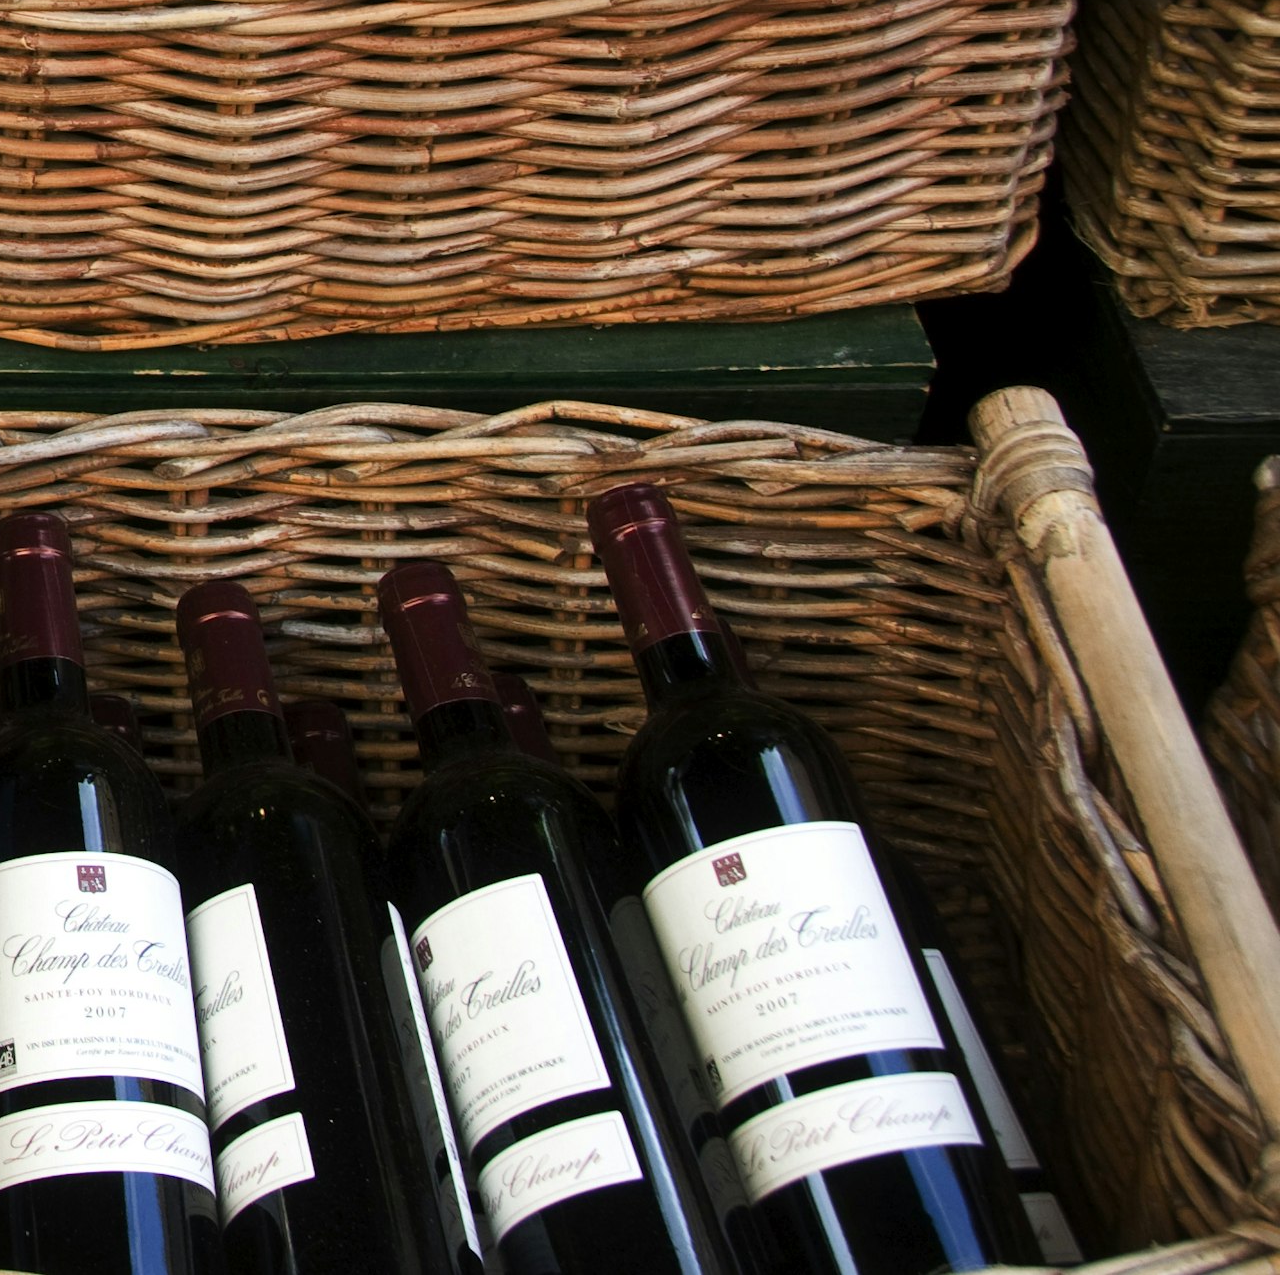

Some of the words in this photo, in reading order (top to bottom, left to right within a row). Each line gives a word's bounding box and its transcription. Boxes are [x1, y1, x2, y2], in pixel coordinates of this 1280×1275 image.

[55, 899, 133, 934] Château
[2, 933, 92, 985] Champ
[96, 942, 129, 970] des
[678, 942, 749, 992] Champ
[755, 926, 788, 961] des
[24, 986, 104, 1004] SAINTE-FOY
[109, 987, 173, 1007] BORDEAUX
[460, 959, 542, 1021] Treilles
[755, 991, 800, 1017] 2007
[83, 1005, 128, 1020] 2007
[53, 1118, 137, 1153] Petit
[135, 1120, 213, 1174] Champ
